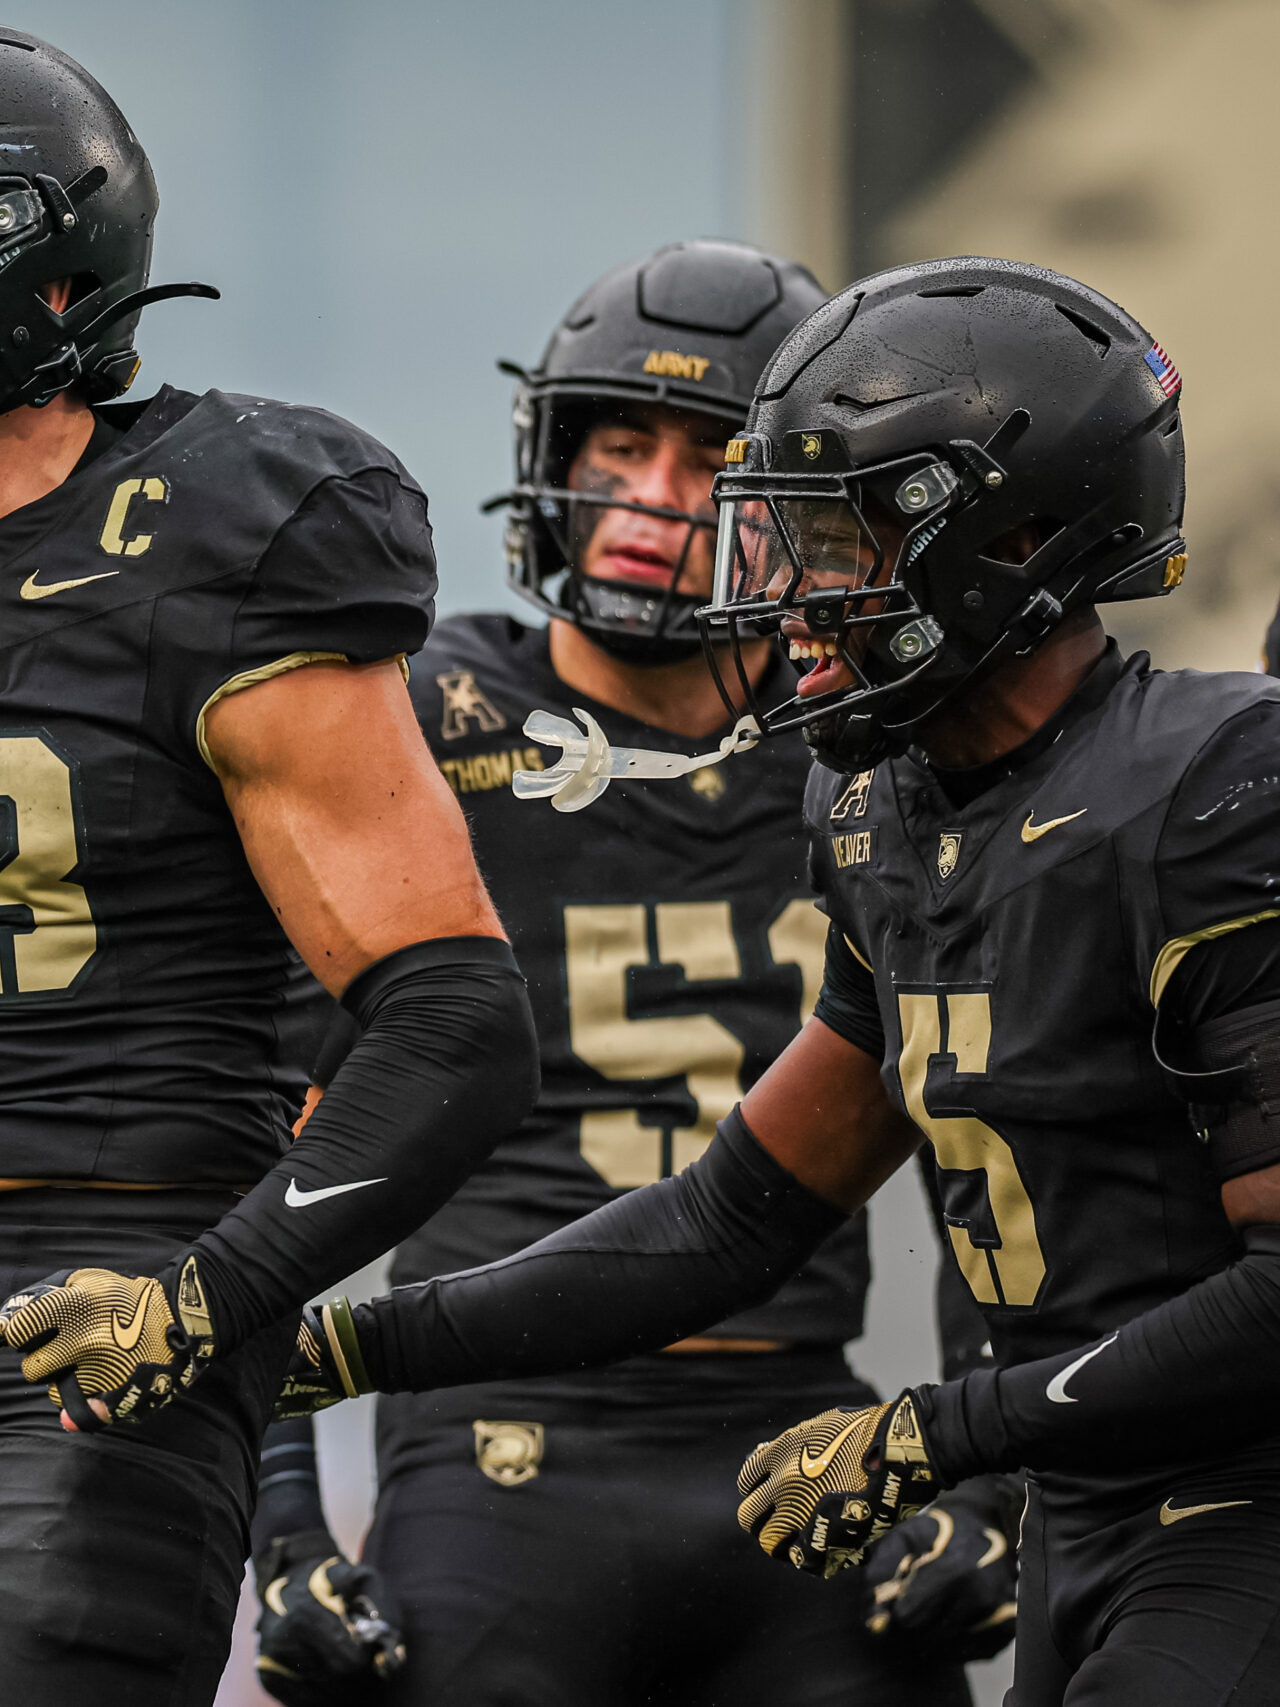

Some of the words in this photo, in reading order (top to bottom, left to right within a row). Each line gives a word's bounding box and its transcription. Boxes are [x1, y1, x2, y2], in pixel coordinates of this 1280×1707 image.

[643, 349, 710, 381] ARMY
[99, 477, 166, 556] C
[898, 992, 1047, 1307] 5
[881, 1470, 902, 1508] ARMY
[810, 1514, 830, 1552] ARMY
